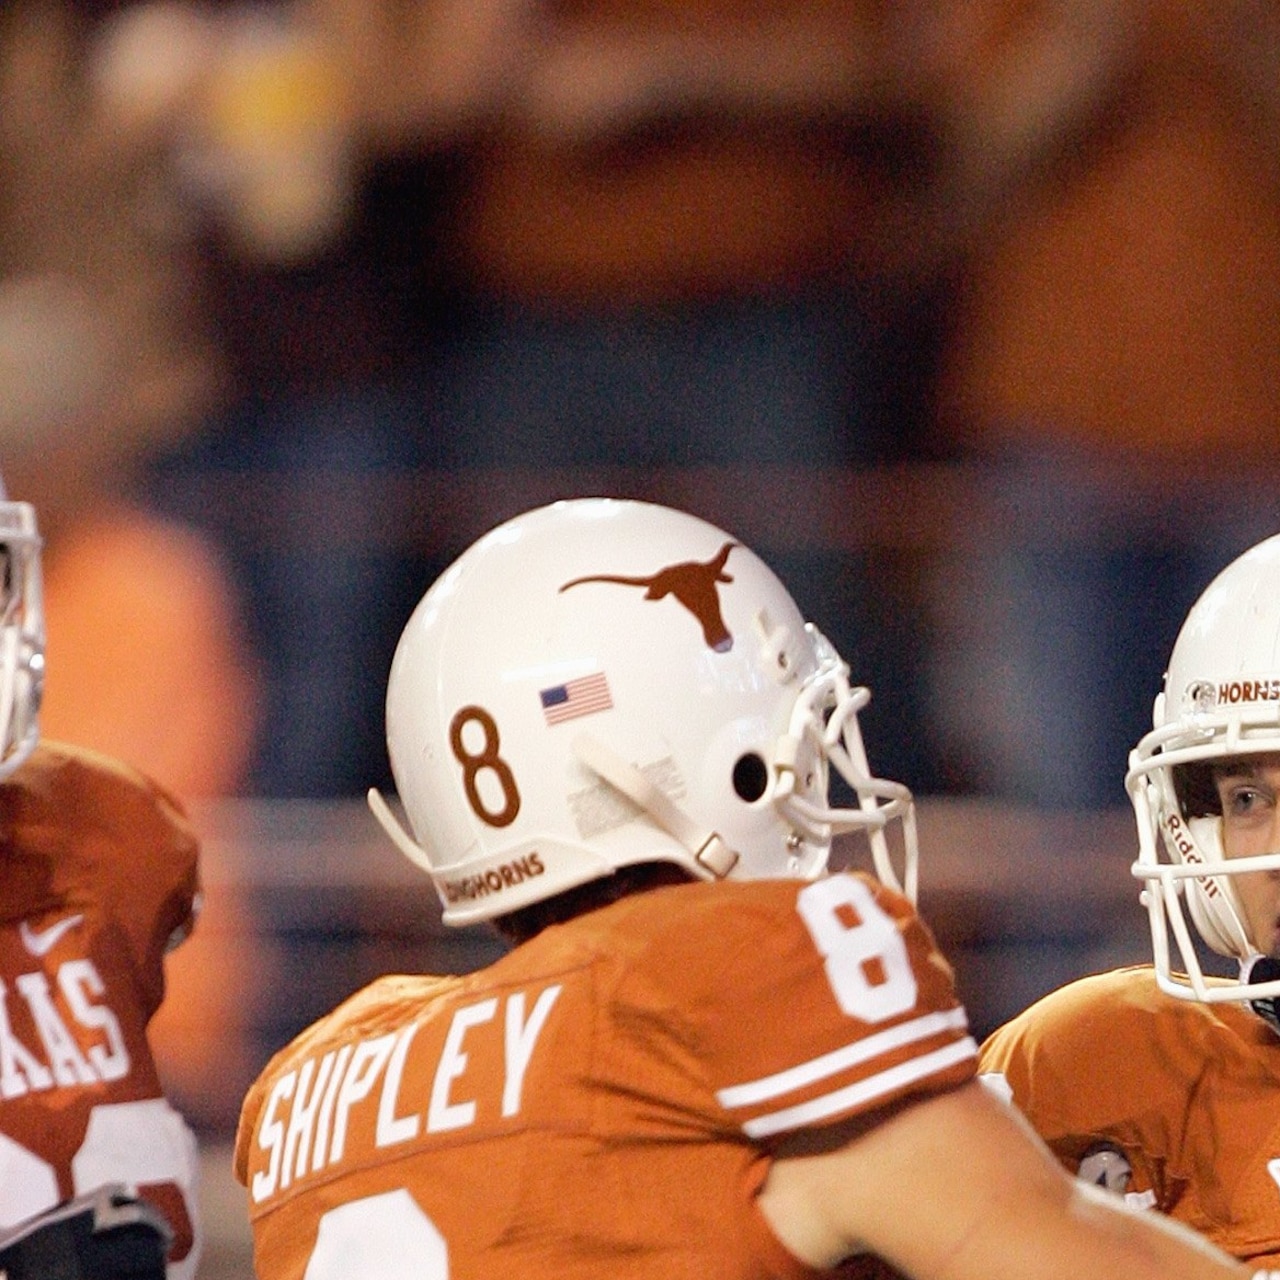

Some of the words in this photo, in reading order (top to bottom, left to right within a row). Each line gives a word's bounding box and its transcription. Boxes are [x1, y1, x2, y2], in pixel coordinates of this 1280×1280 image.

[449, 704, 522, 829] 8
[797, 875, 919, 1024] 8
[253, 985, 563, 1203] SHIPLEY
